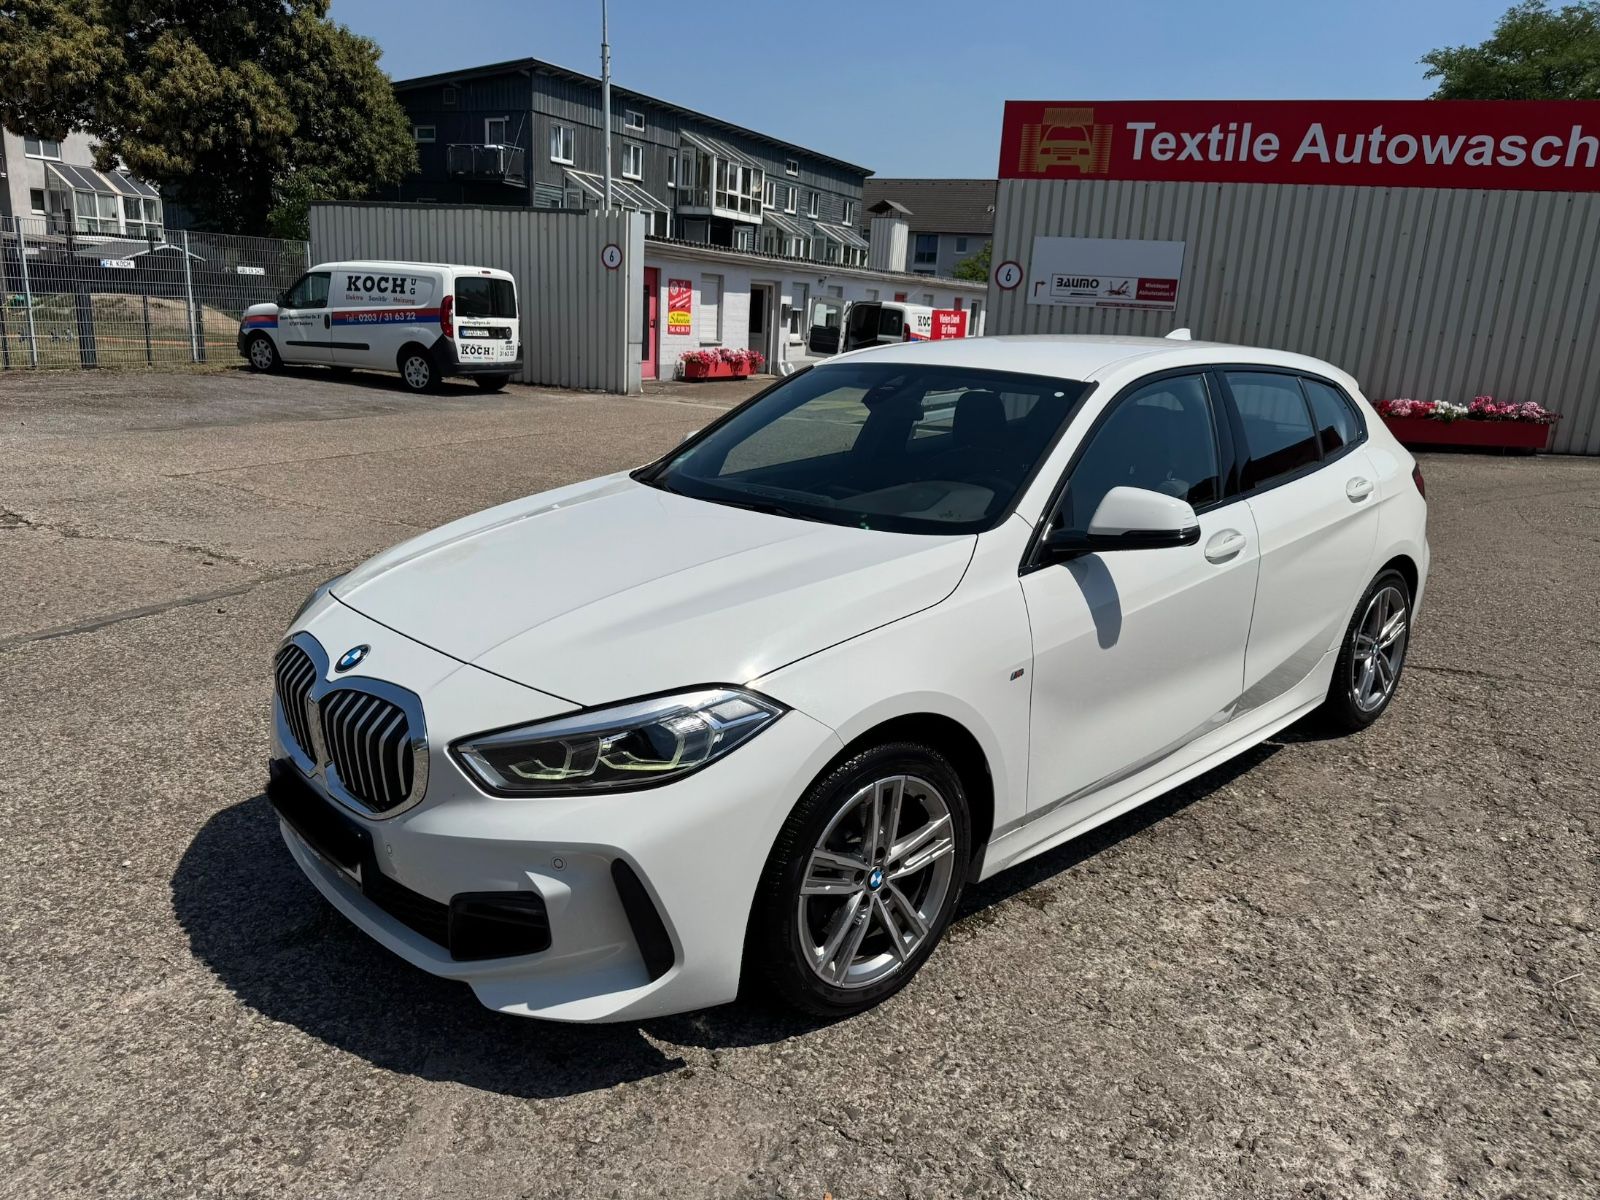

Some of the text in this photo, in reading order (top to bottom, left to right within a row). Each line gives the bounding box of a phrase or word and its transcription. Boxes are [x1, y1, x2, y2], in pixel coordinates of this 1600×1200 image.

[1126, 122, 1600, 168] Textile Autowasch
[609, 250, 615, 263] 6
[1005, 268, 1012, 282] 6
[346, 275, 407, 294] KOCH
[1056, 277, 1100, 289] BAUMO
[358, 312, 378, 322] 0203
[384, 312, 393, 321] 31
[395, 311, 405, 321] 63
[406, 311, 417, 320] 22
[917, 315, 932, 327] KOC
[951, 314, 960, 324] Dank
[461, 345, 490, 355] KOCH
